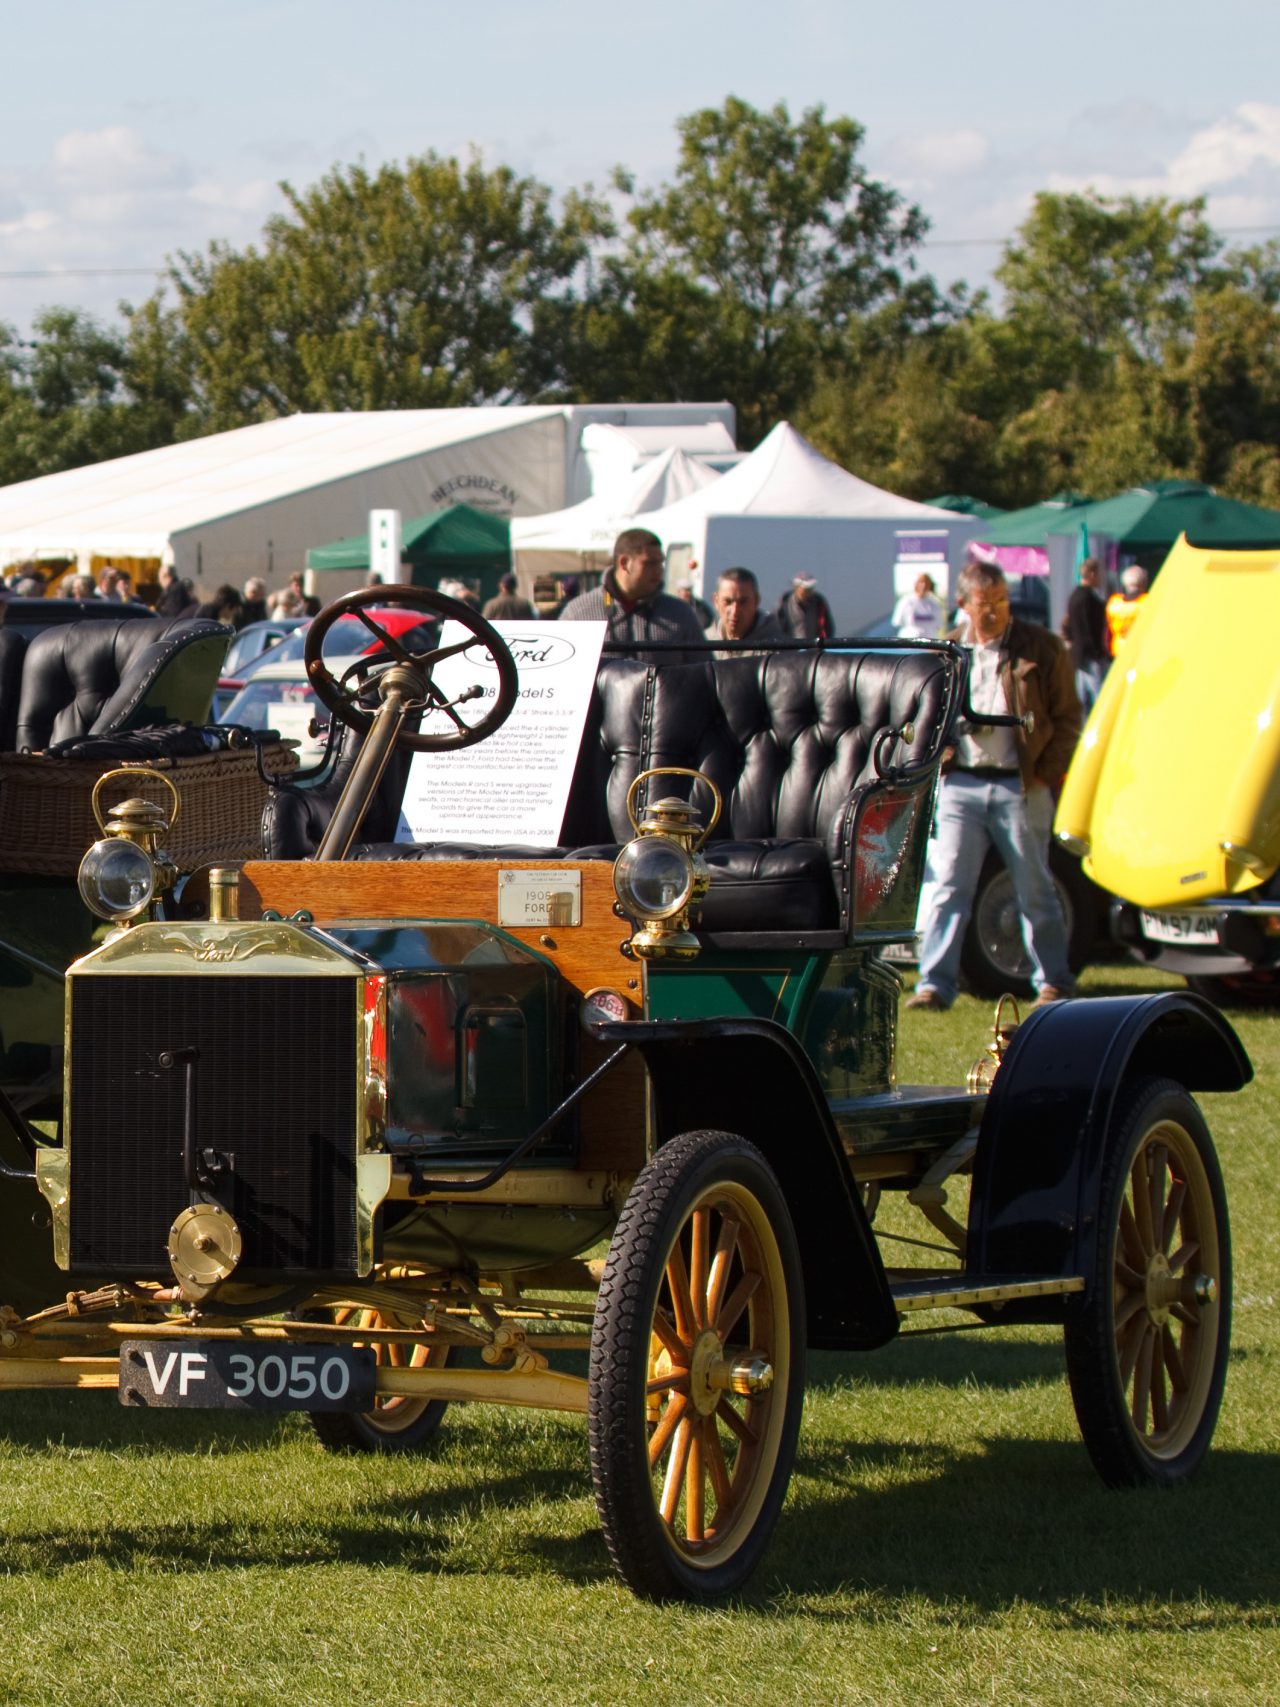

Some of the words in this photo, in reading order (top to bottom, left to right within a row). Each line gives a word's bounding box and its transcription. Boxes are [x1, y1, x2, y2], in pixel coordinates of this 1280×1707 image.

[546, 687, 555, 699] S
[525, 903, 552, 913] FORD
[143, 1352, 207, 1396] VF
[227, 1354, 350, 1400] 3050
